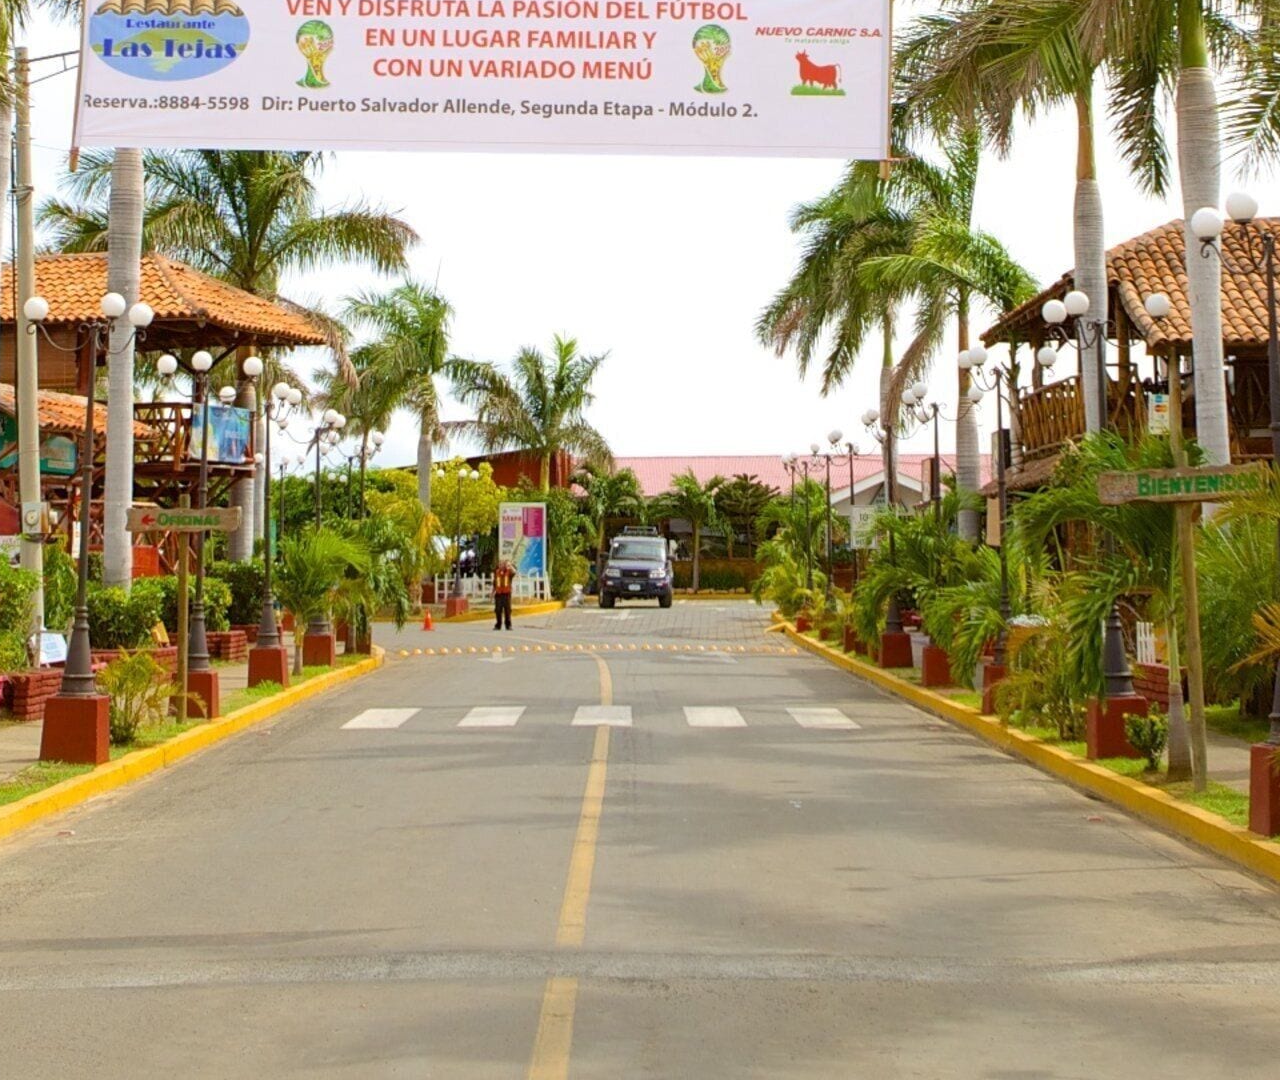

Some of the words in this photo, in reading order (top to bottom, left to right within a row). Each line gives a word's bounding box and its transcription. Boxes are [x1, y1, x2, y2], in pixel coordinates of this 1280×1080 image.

[358, 0, 470, 18] DISFRUTA
[477, 0, 505, 18] LA
[606, 1, 649, 19] DEL
[126, 18, 215, 30] Restaurante
[755, 26, 803, 36] NUEVO
[806, 27, 857, 37] CARNIC
[860, 28, 883, 37] S.A.
[103, 38, 153, 58] Las
[162, 38, 238, 59] Tejas
[365, 28, 395, 46] EN
[403, 29, 435, 47] UN
[443, 29, 520, 48] LUGAR
[527, 30, 636, 49] FAMILIAR
[643, 31, 657, 49] Y
[373, 58, 421, 77] CON
[430, 59, 462, 77] UN
[469, 60, 575, 79] VARIADO
[582, 58, 652, 80] MENÚ
[262, 96, 293, 111] Dir:
[298, 97, 356, 112] Puerto
[361, 98, 439, 113] Salvador
[443, 99, 516, 115] Allende,
[520, 100, 598, 119] Segunda
[603, 101, 653, 119] Etapa
[669, 101, 737, 117] Módulo
[742, 103, 759, 117] 2.
